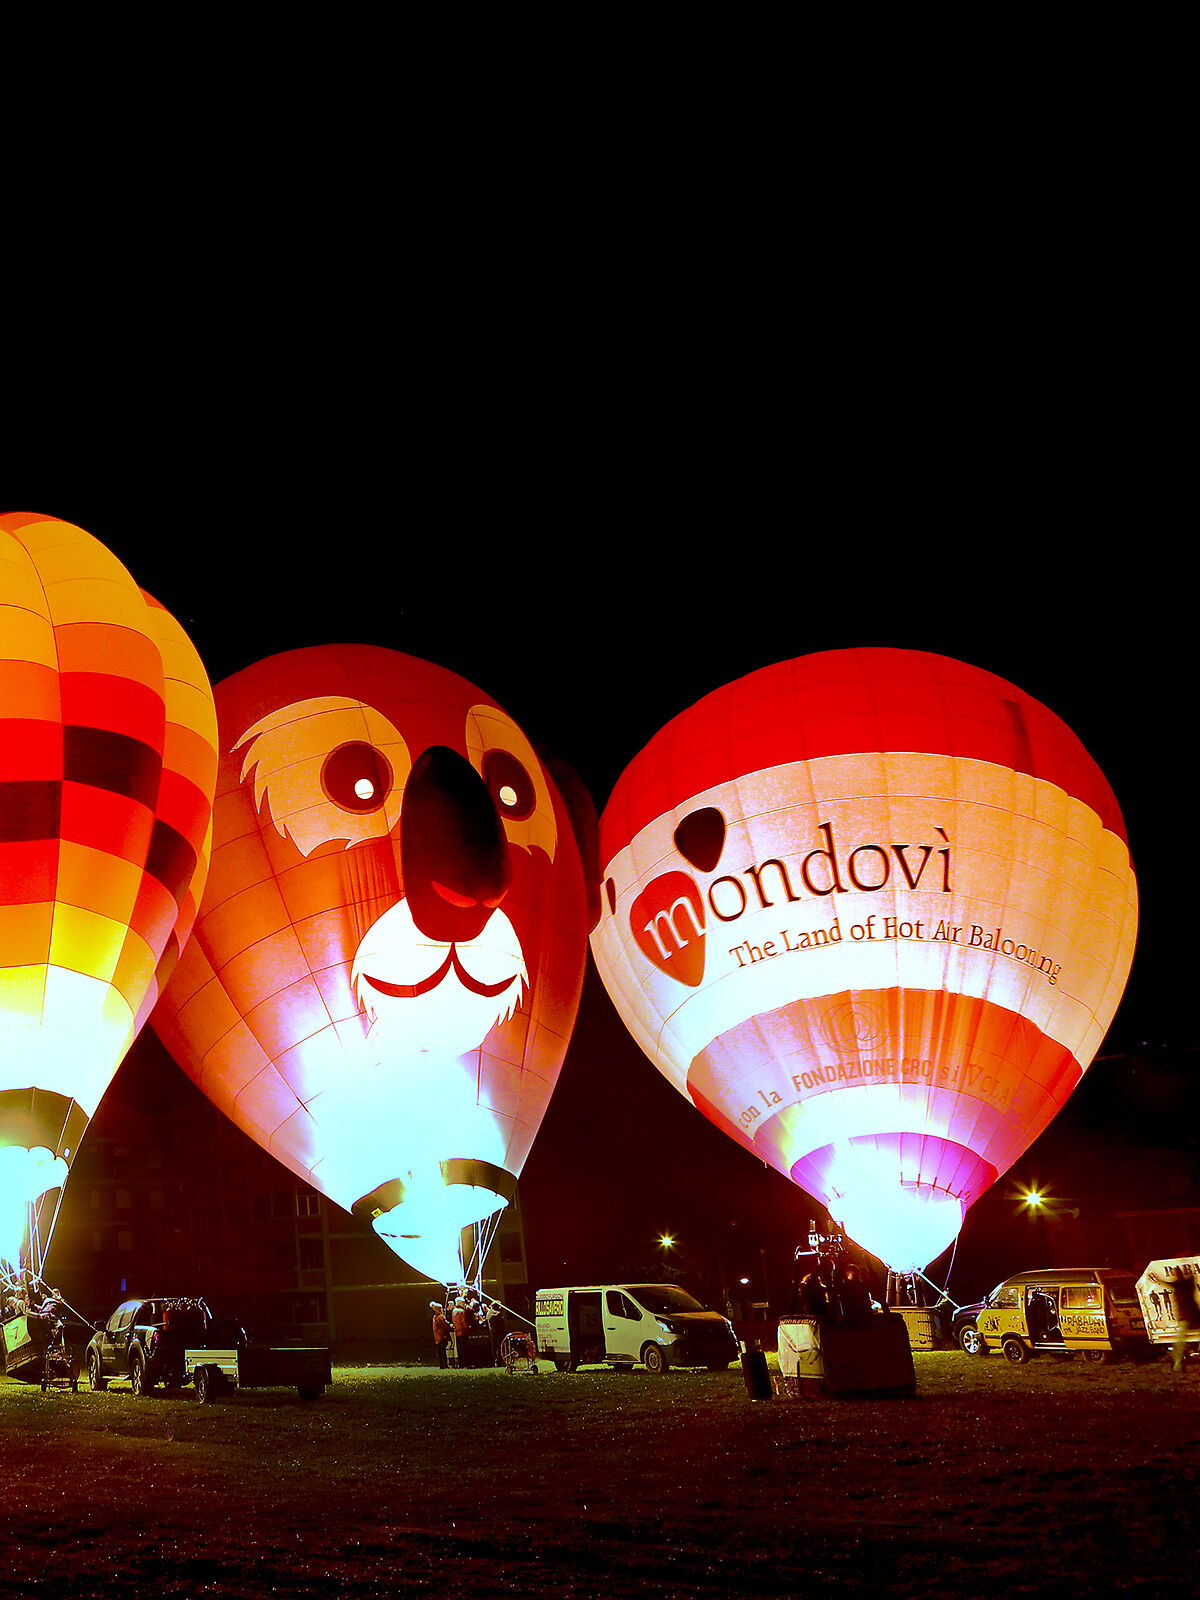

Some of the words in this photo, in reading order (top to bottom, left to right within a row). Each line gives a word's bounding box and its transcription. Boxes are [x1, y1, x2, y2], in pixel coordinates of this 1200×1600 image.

[644, 821, 954, 961] mondovì
[729, 940, 779, 968] The
[779, 917, 843, 952] Land
[849, 914, 877, 940] of
[883, 916, 925, 939] Hot
[931, 919, 963, 943] Air
[738, 1103, 761, 1129] con
[758, 1089, 783, 1108] la
[792, 1058, 895, 1092] FONDAZIONE
[901, 1057, 933, 1078] CRC
